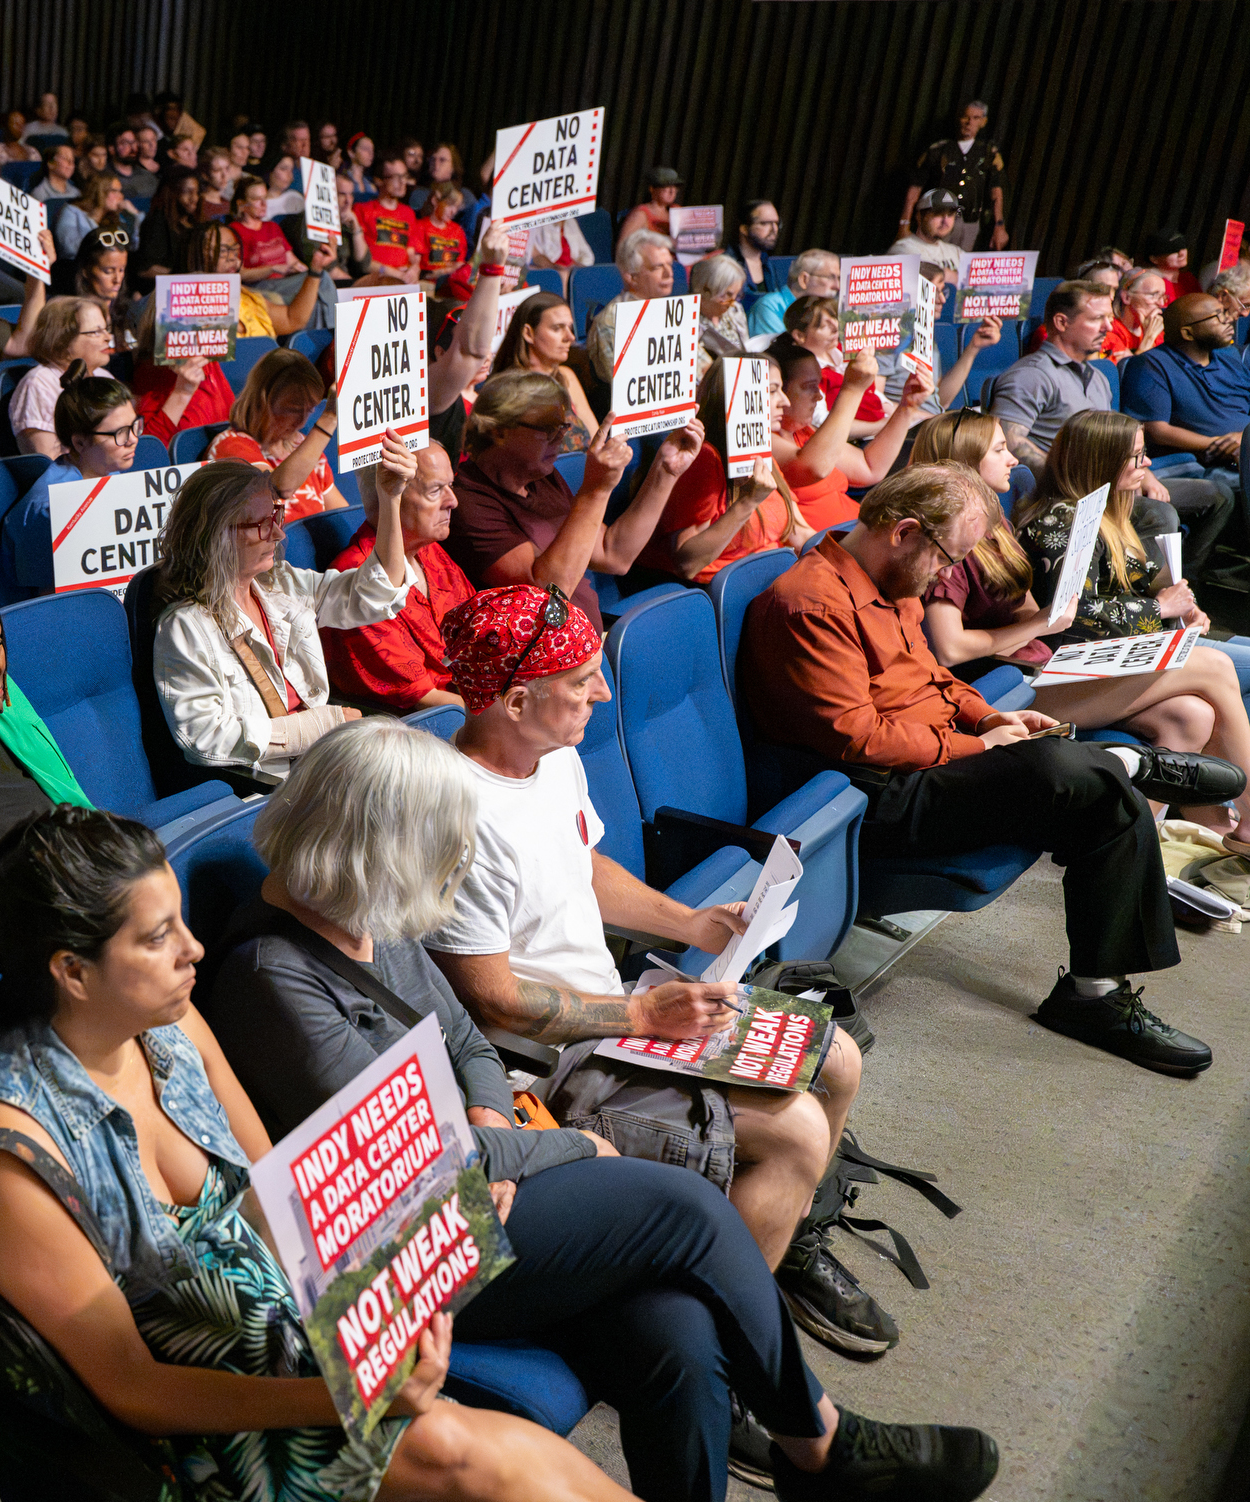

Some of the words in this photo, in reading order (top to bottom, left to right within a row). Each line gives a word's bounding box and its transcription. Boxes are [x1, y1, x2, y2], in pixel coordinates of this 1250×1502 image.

[556, 116, 580, 142] NO
[533, 144, 577, 175] DATA
[10, 185, 29, 211] NO
[508, 173, 579, 210] CENTER.
[851, 268, 871, 281] INDY
[871, 264, 901, 278] NEEDS
[972, 258, 992, 269] INDY
[993, 257, 1024, 268] NEEDS
[171, 283, 197, 295] INDY
[198, 283, 229, 294] NEEDS
[855, 282, 872, 291] DATA
[871, 279, 901, 289] CENTER
[969, 275, 1022, 285] MORATORIUM
[172, 296, 179, 304] A
[179, 295, 200, 304] DATA
[200, 295, 228, 304] CENTER
[849, 290, 901, 304] MORATORIUM
[965, 296, 986, 308] NOT
[987, 295, 1021, 306] WEAK
[171, 305, 228, 316] MORATORIUM
[387, 296, 408, 333] NO
[665, 299, 684, 328] NO
[963, 306, 1020, 318] REGULATIONS
[168, 331, 197, 345] NOT
[197, 329, 229, 344] WEAK
[845, 321, 865, 337] NOT
[865, 318, 901, 335] WEAK
[167, 344, 228, 357] REGULATIONS
[371, 339, 411, 380] DATA
[647, 334, 682, 366] DATA
[751, 360, 762, 384] NO
[627, 370, 684, 407] CENTER.
[353, 383, 415, 431] CENTER.
[744, 390, 764, 415] DATA
[735, 422, 766, 448] CENTER.
[144, 467, 182, 498] NO
[114, 502, 166, 536] DAT
[1083, 644, 1125, 665] DATA
[740, 1006, 784, 1055] WEAK
[765, 1013, 810, 1085] REGULATIONS
[728, 1052, 766, 1079] NOT
[294, 1123, 352, 1200] INDY
[351, 1062, 423, 1148] NEEDS
[310, 1201, 326, 1230] A
[325, 1158, 368, 1217] DATA
[366, 1098, 431, 1168] CENTER
[316, 1133, 440, 1266] MORATORIUM
[337, 1267, 395, 1360] NOT
[391, 1193, 470, 1294] WEAK
[356, 1235, 481, 1397] REGULATIONS
